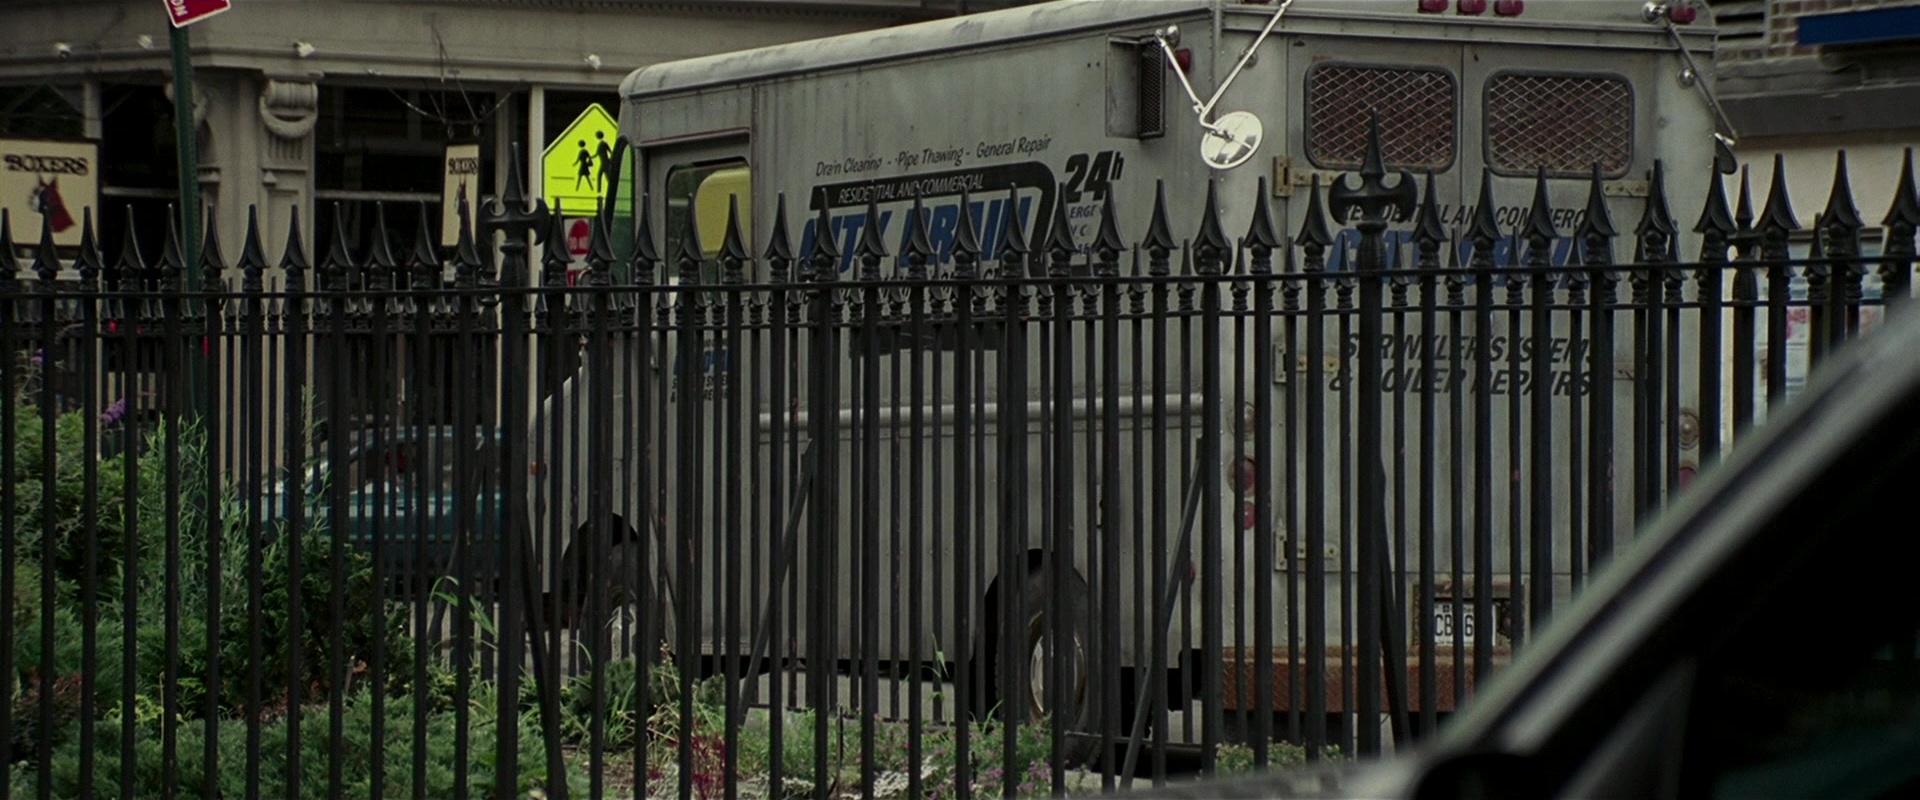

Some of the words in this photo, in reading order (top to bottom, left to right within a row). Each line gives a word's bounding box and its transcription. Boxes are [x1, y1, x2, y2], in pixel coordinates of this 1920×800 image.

[896, 150, 920, 171] Pipe
[976, 140, 1017, 159] General
[1017, 134, 1052, 157] Repair
[4, 154, 89, 177] BOXERS
[837, 183, 896, 205] RESIDETIAL
